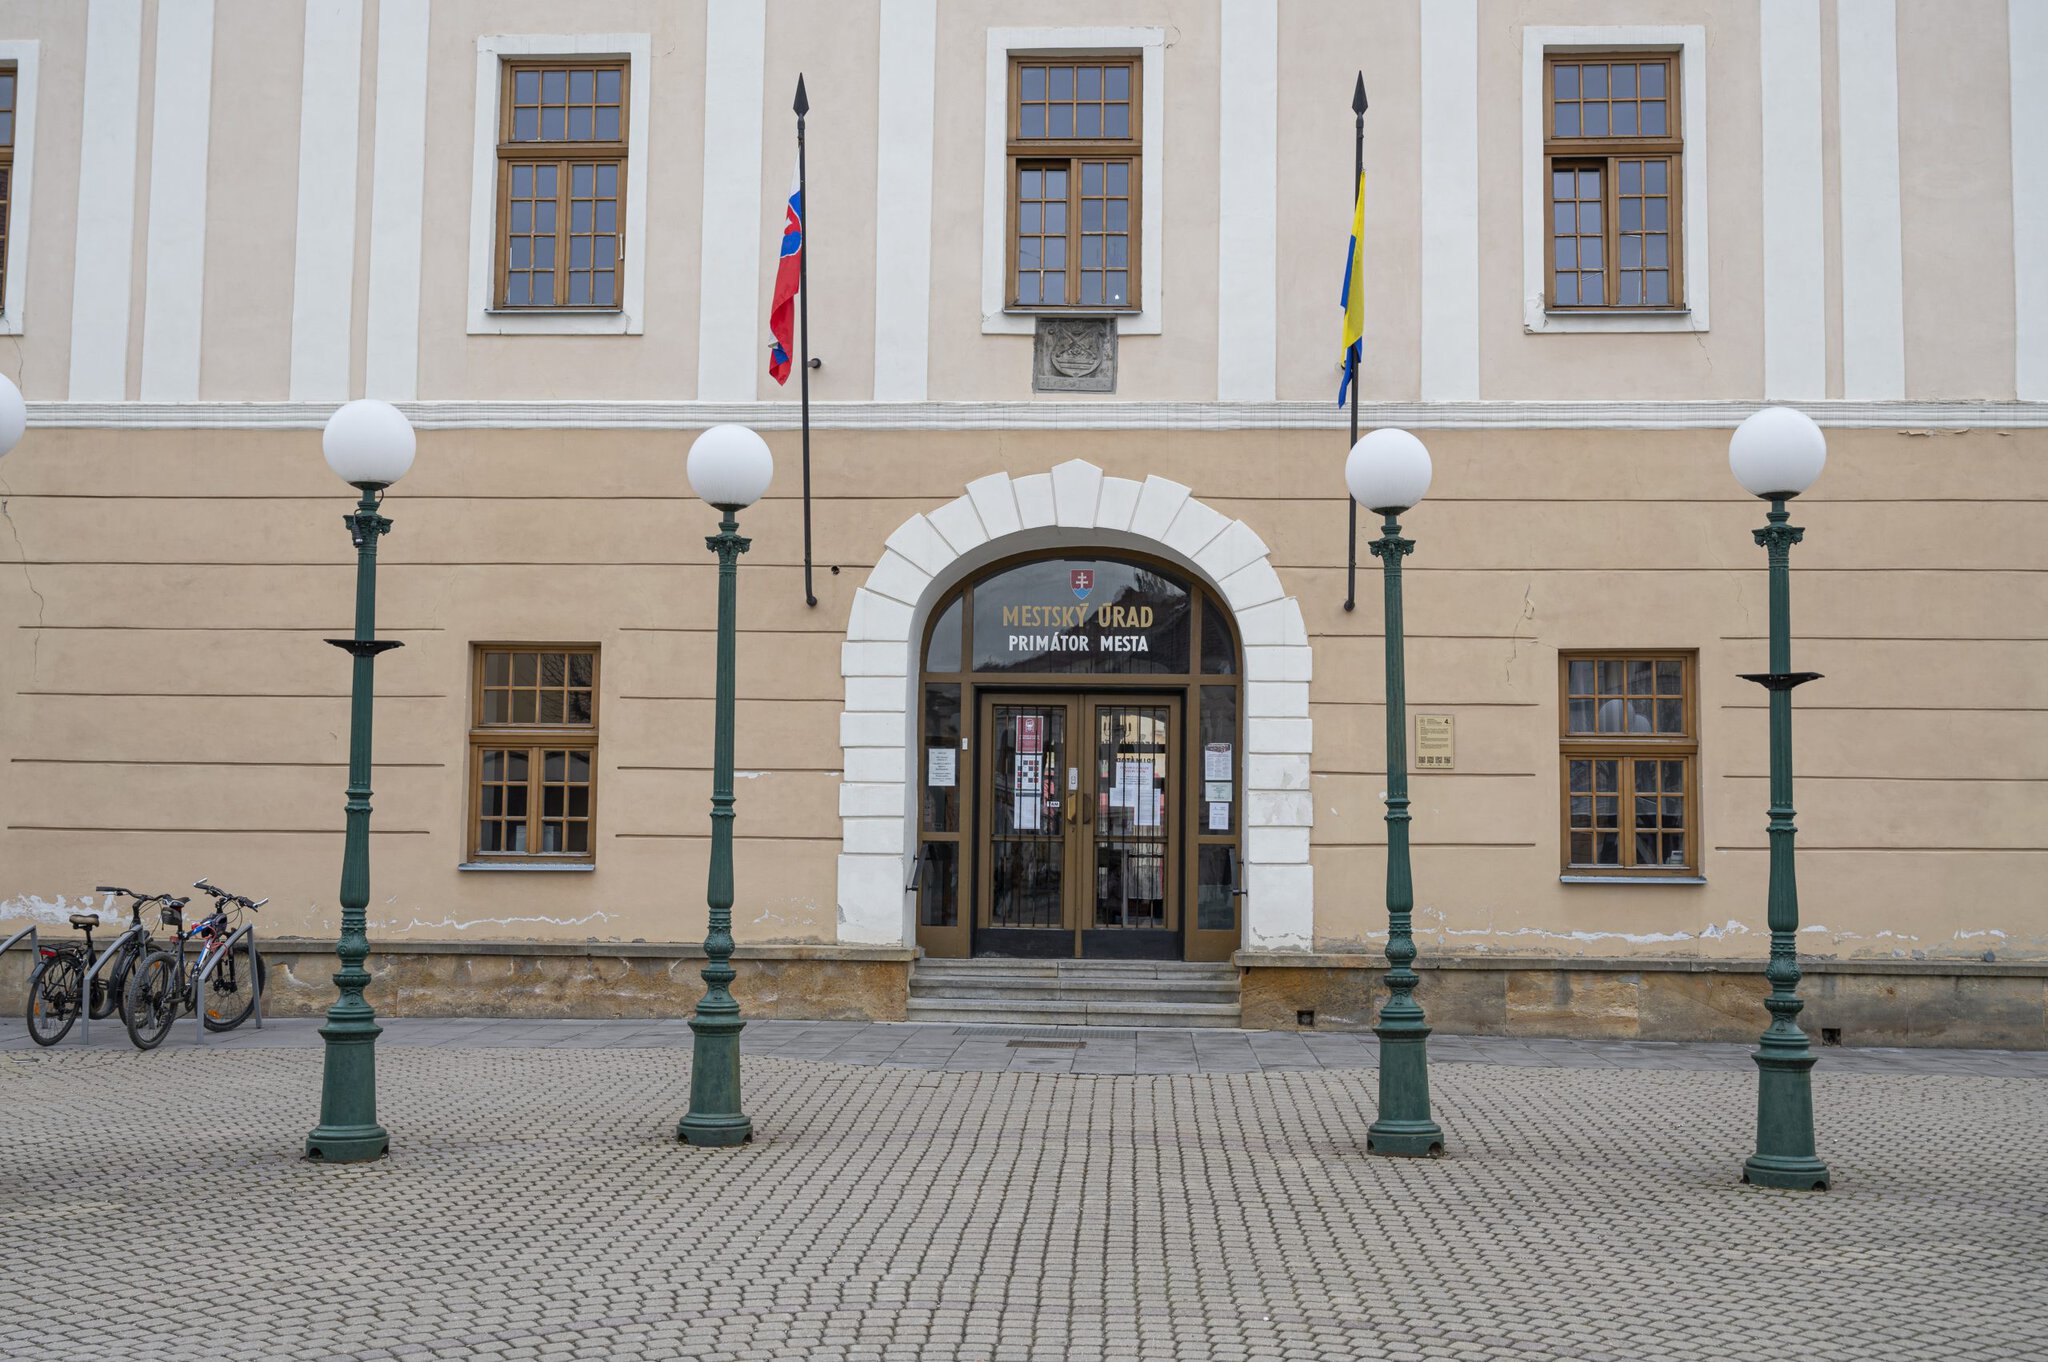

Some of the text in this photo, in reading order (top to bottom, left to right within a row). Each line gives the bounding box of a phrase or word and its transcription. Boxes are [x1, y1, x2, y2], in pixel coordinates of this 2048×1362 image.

[1003, 603, 1153, 628] MESTSKÝ ÚRAD
[1009, 632, 1149, 652] PRIMÁTOR MESTA
